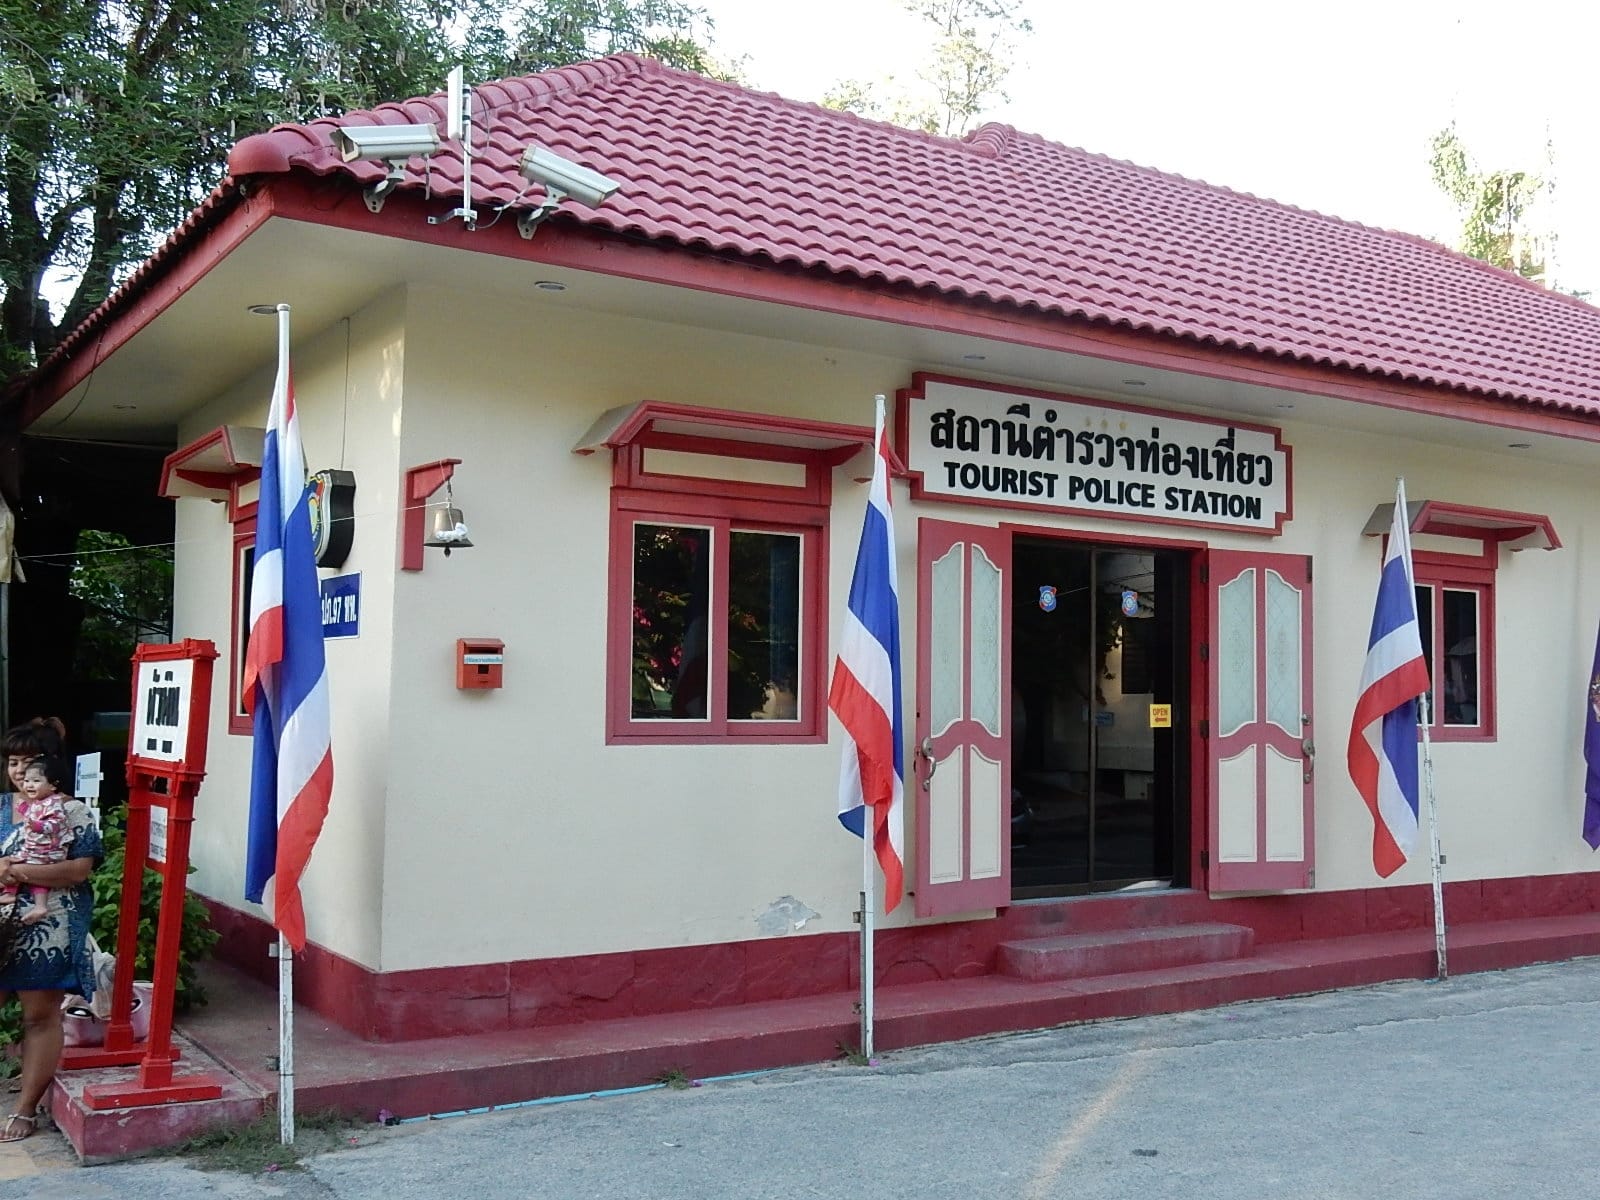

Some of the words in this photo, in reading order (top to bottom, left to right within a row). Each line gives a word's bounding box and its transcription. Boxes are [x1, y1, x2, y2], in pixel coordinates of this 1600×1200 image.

[930, 403, 1273, 487] สถานีตำรวจท่องเที่ยว
[944, 461, 1058, 498] TOURIST
[1068, 475, 1155, 509] POLICE
[1165, 486, 1262, 520] STATION
